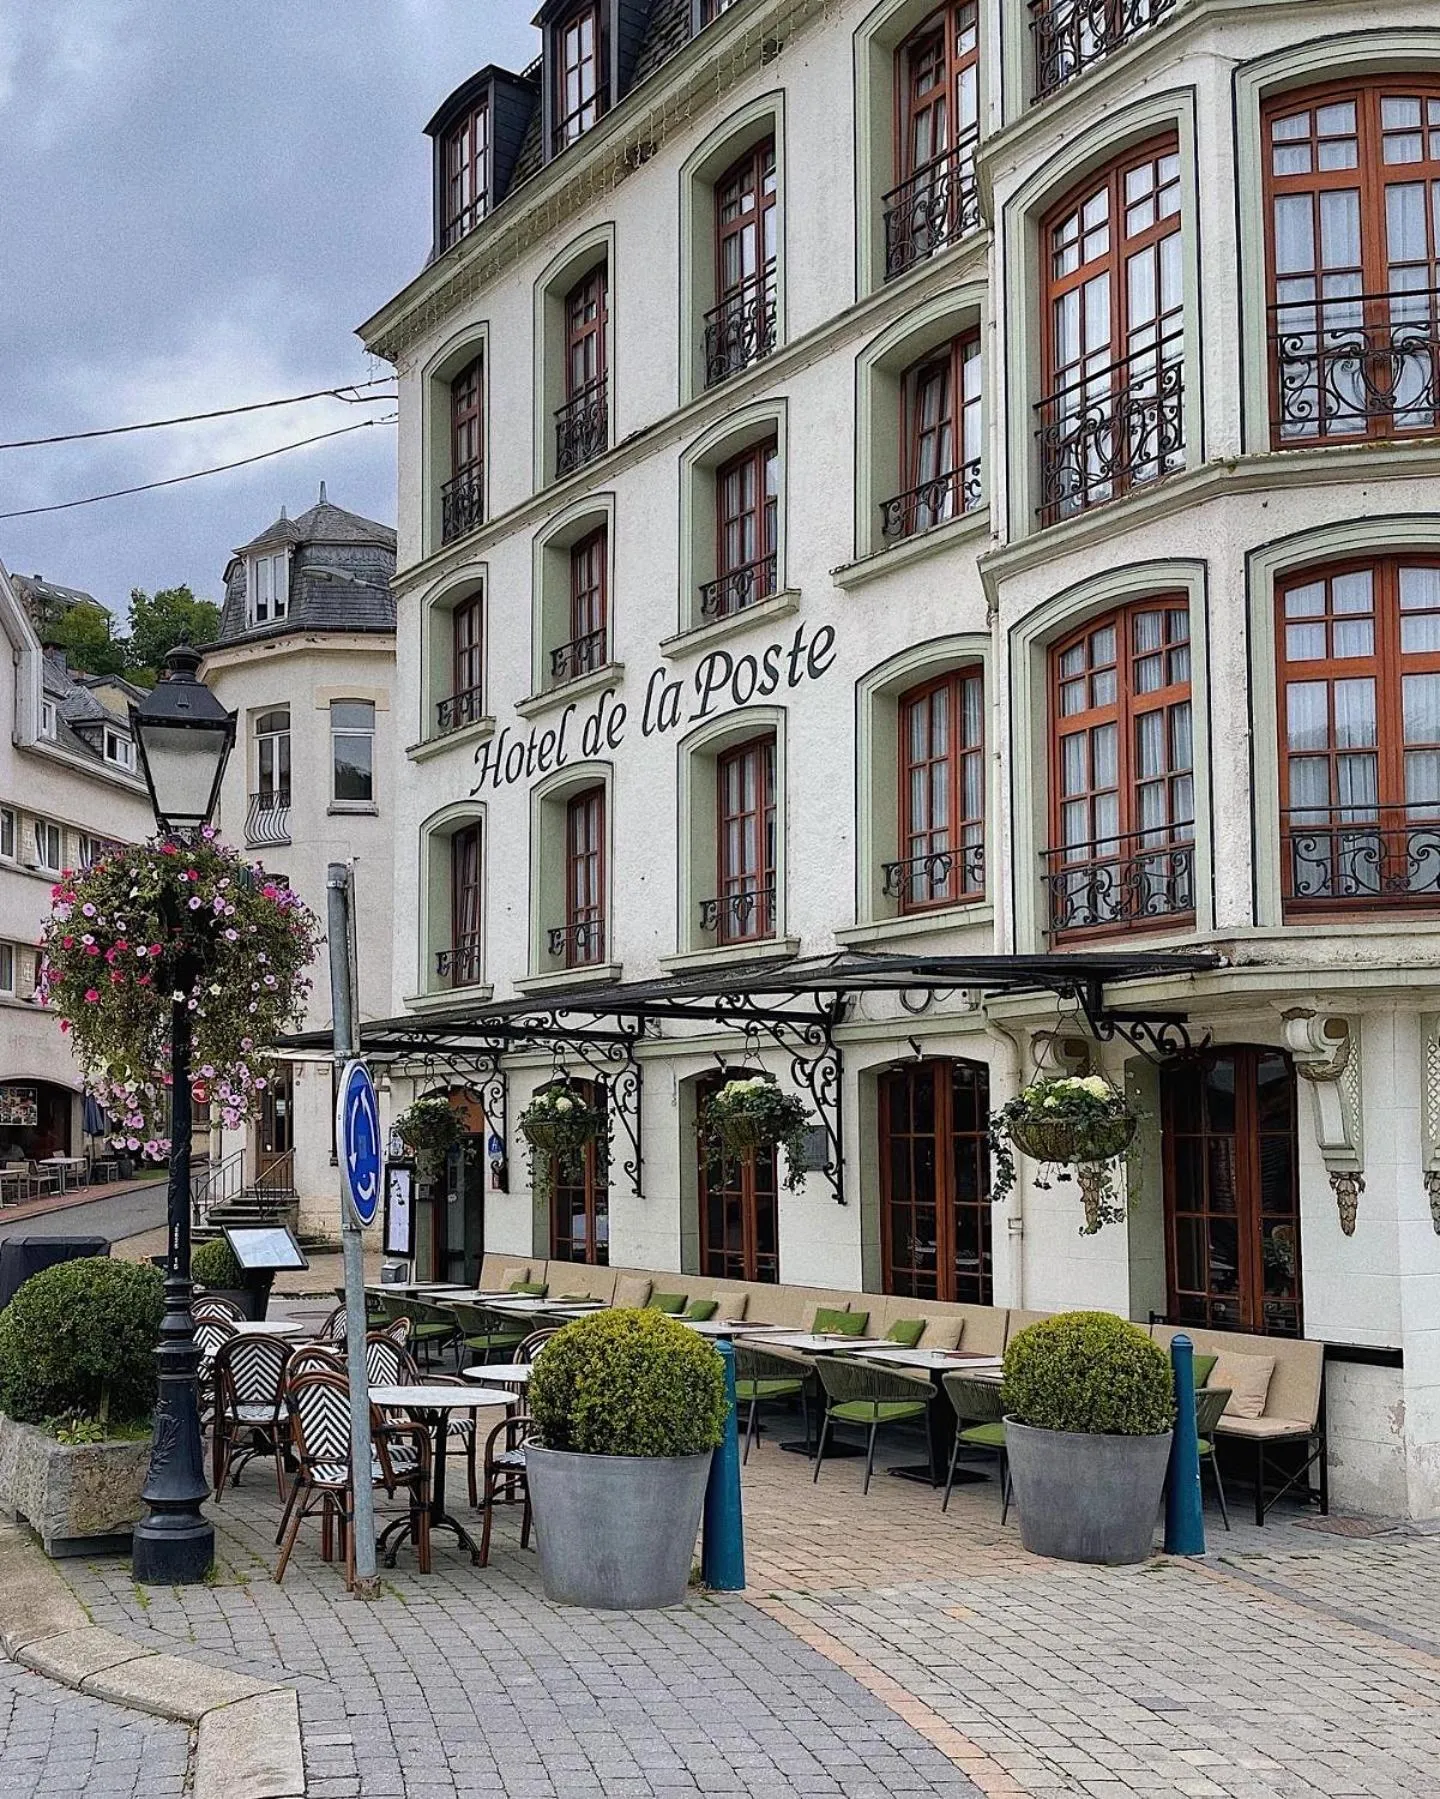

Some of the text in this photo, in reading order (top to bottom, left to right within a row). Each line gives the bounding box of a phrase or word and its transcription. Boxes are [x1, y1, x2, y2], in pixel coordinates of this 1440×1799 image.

[470, 621, 837, 796] Hotel de la Poste
